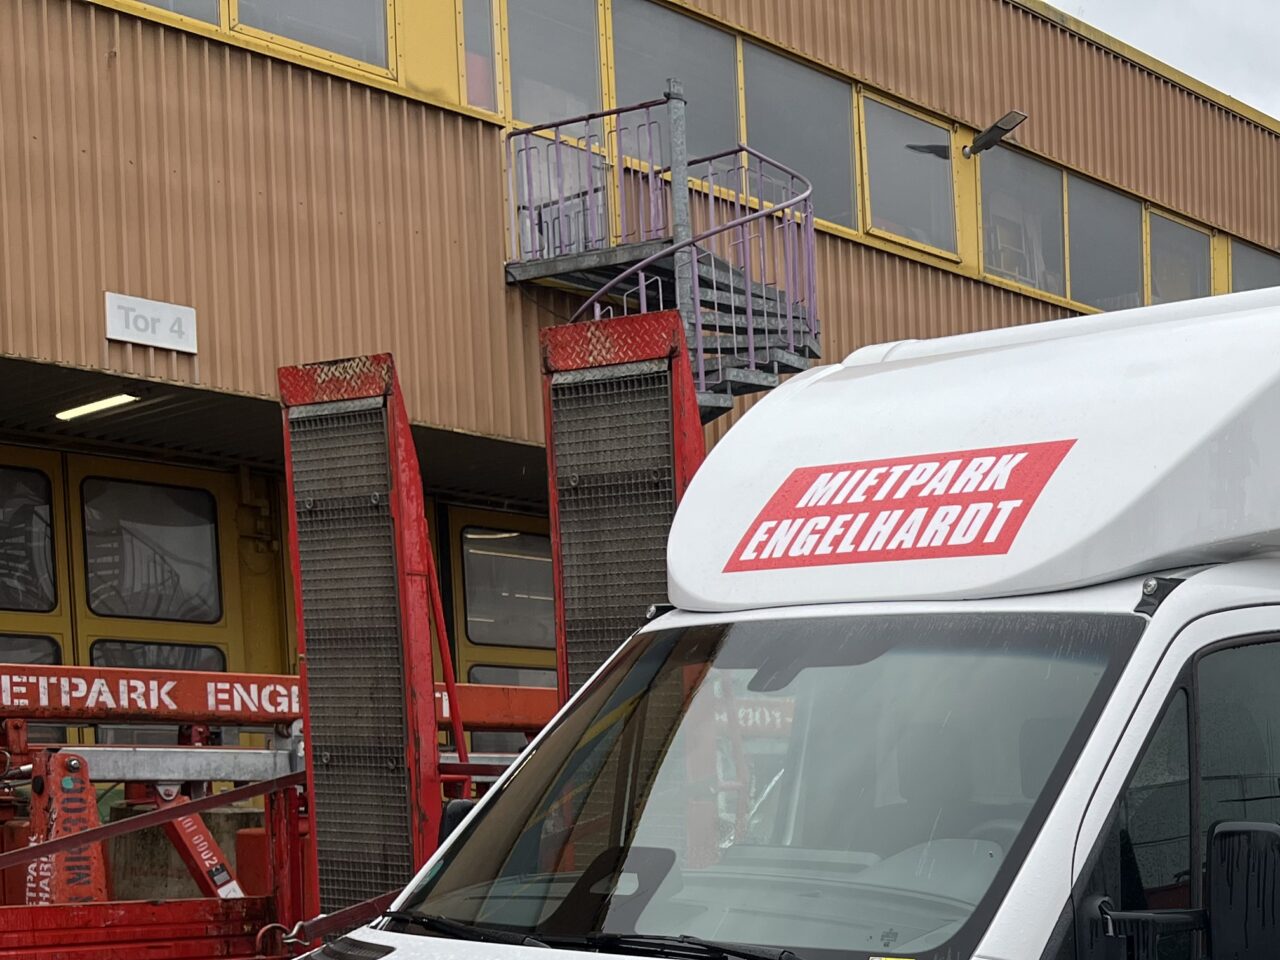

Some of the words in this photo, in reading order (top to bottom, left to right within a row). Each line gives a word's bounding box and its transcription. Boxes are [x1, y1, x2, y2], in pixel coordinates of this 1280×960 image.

[117, 305, 160, 335] Tor
[169, 317, 186, 339] 4
[796, 452, 1028, 508] MIETPARK
[739, 500, 1023, 561] ENGELHARDT
